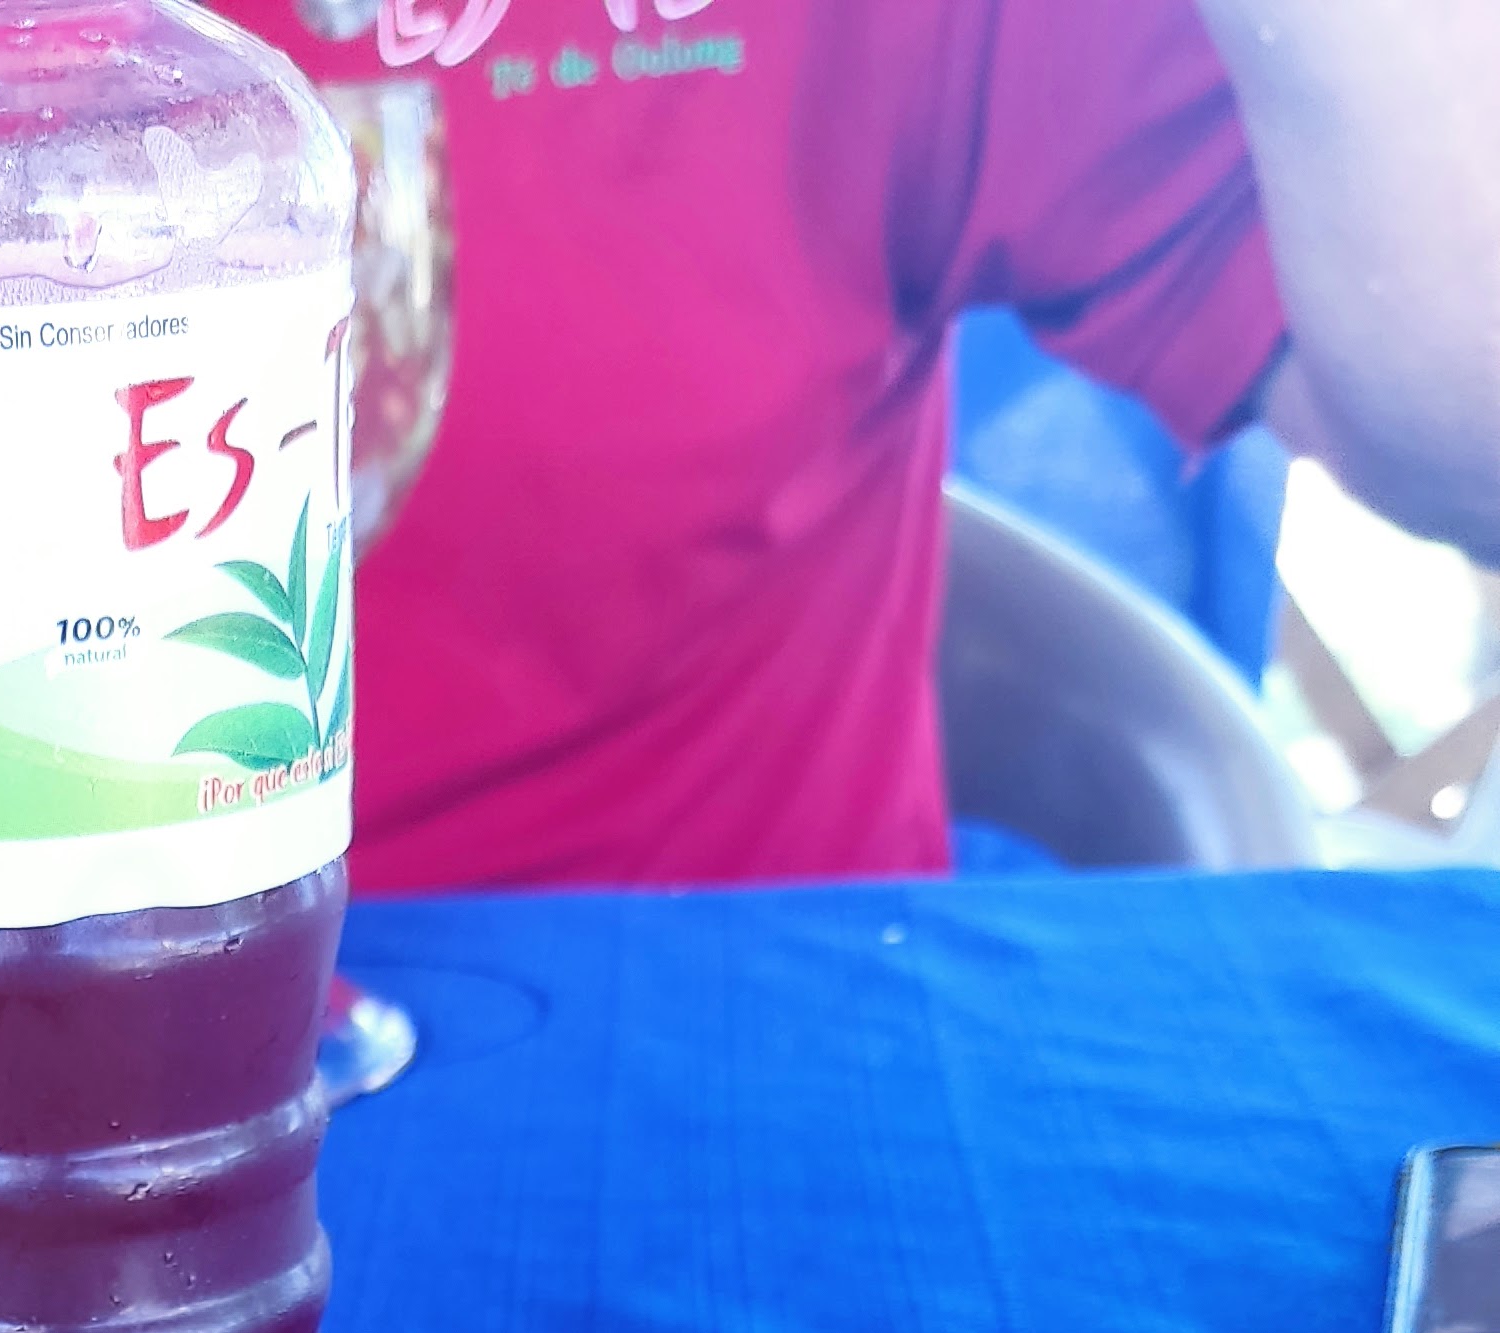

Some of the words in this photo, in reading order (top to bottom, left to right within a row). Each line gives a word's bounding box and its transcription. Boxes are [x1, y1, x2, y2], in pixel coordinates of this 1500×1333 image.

[0, 324, 32, 350] Sin
[40, 314, 190, 348] Conseradores
[56, 615, 141, 646] 100%
[64, 642, 127, 666] natural
